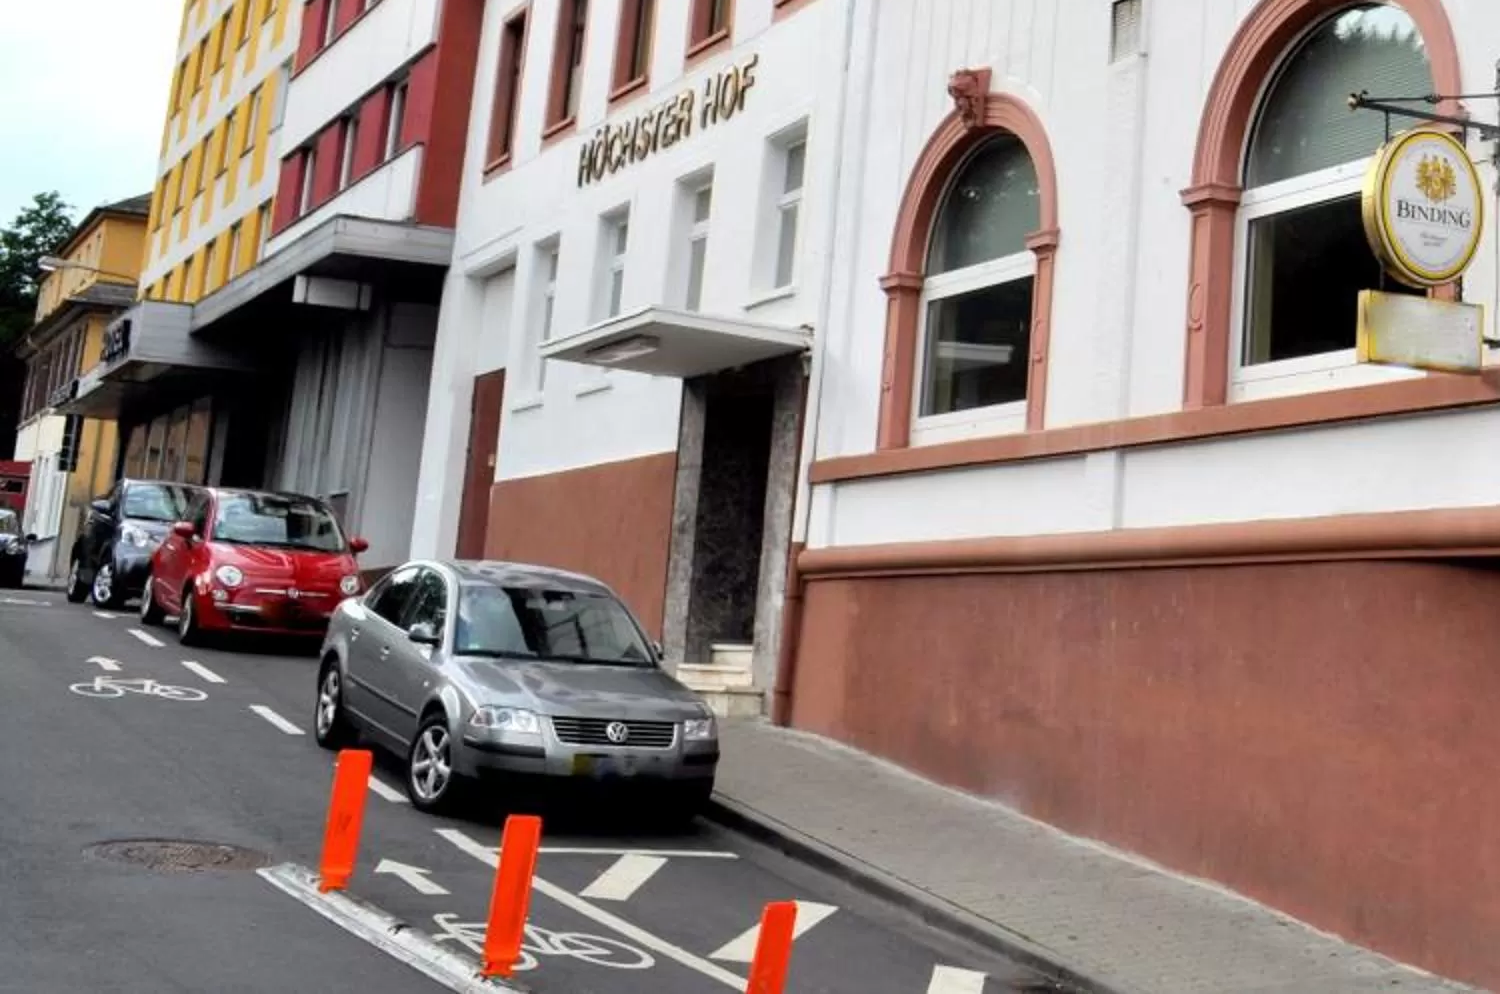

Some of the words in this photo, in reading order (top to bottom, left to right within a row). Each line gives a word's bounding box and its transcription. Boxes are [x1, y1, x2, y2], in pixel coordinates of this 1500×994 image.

[577, 89, 695, 188] HÖCHSTER
[700, 53, 759, 129] HOF
[1396, 199, 1471, 228] BINDING
